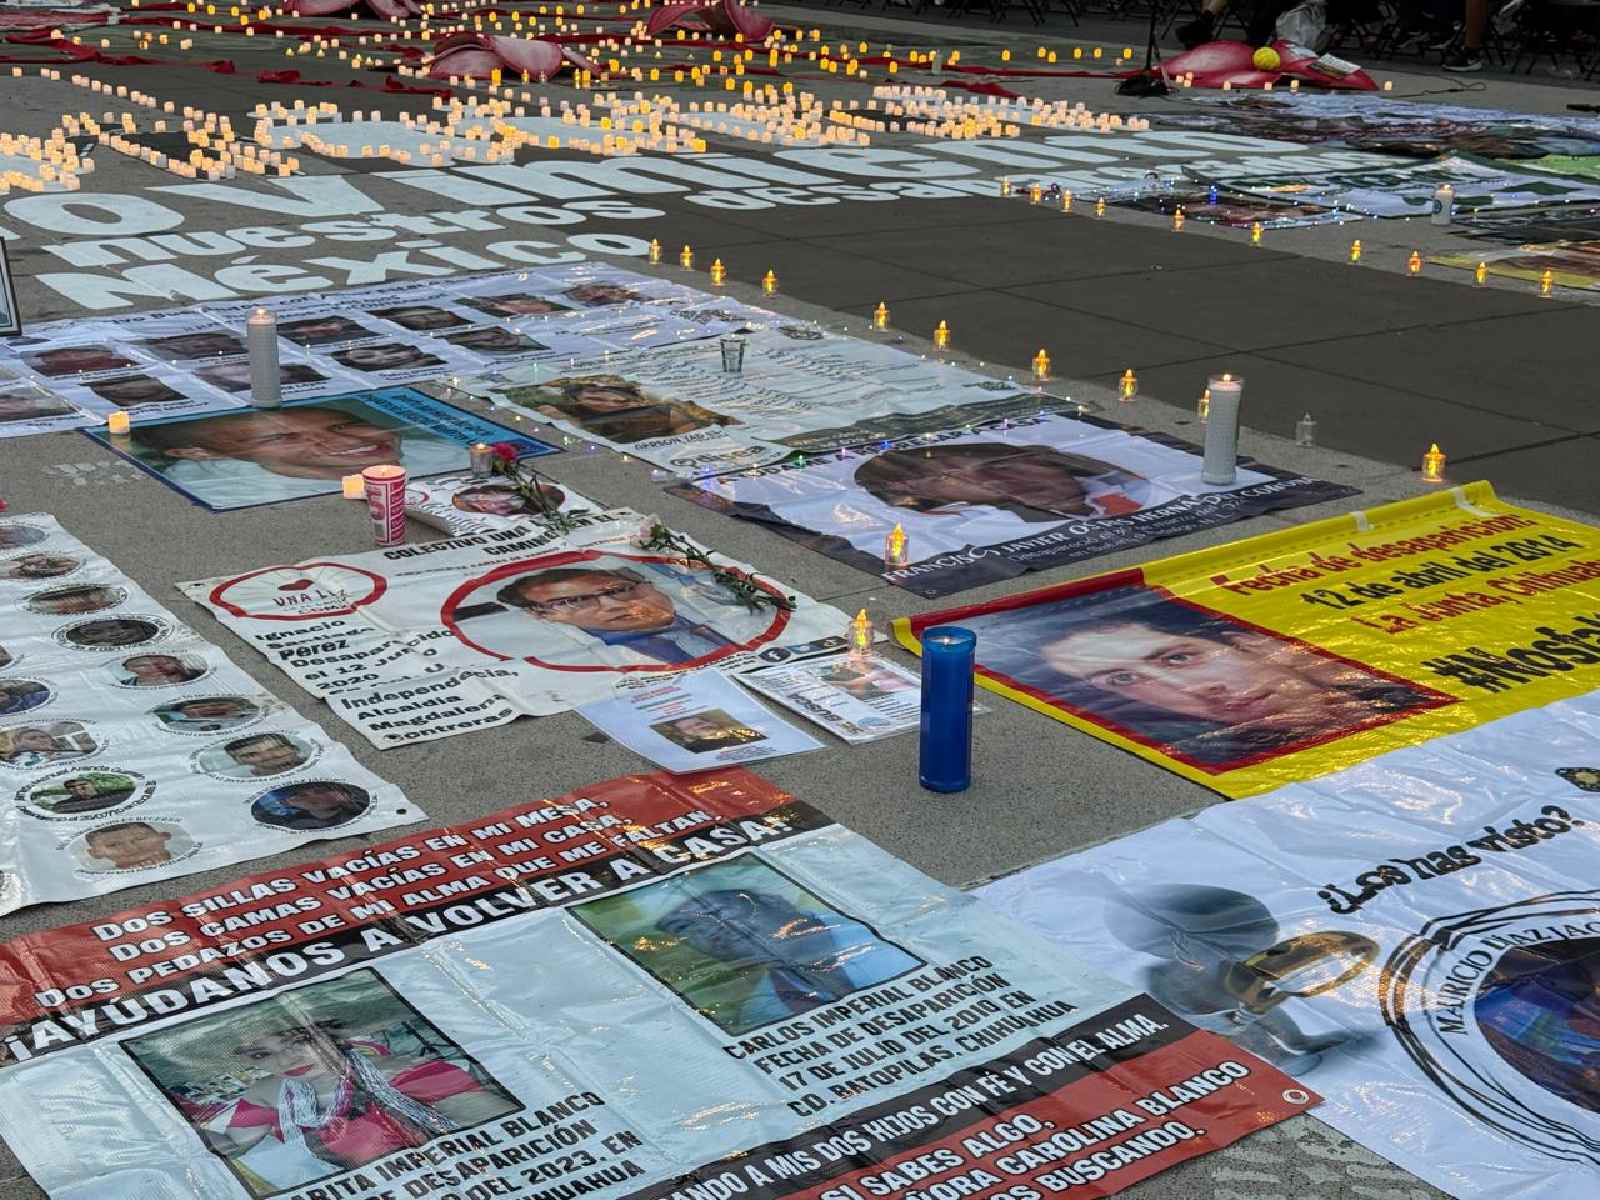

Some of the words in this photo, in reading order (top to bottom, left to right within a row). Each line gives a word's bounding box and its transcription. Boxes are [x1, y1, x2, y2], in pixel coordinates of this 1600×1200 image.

[34, 233, 653, 310] México
[42, 200, 666, 267] nuestros
[1300, 589, 1366, 610] 12
[1345, 581, 1405, 600] de
[1391, 561, 1473, 589] abril
[1451, 550, 1519, 573] del
[1490, 534, 1585, 561] 2014
[1307, 551, 1363, 572] de
[316, 673, 380, 690] 2020
[35, 978, 121, 1008] DOS
[127, 929, 293, 985] PEDAZOS
[297, 914, 346, 936] DE
[348, 899, 396, 922] MI
[401, 873, 492, 907] ALMA
[495, 855, 556, 882] QUE
[558, 841, 608, 863] ME
[610, 809, 723, 848] FALTAN.
[92, 911, 174, 942] DOS
[181, 877, 297, 918] SILLAS
[301, 844, 422, 884] VACÍAS
[424, 834, 468, 852] EN
[471, 822, 512, 842] MI
[109, 930, 191, 961] DOS
[200, 896, 322, 938] CAMAS
[327, 862, 446, 900] VACÍAS
[448, 850, 493, 871] EN
[498, 838, 538, 857] MI
[4, 941, 346, 1062] ¡AYÚDANOS
[359, 927, 402, 953] A
[404, 870, 602, 934] VOLVER
[608, 857, 652, 882] A
[721, 1019, 816, 1060] CARLOS
[810, 984, 916, 1028] IMPERIAL
[906, 955, 994, 993] BLANCO
[1436, 949, 1494, 1036] MAURICIO
[753, 1041, 833, 1076] FECHA
[827, 1026, 866, 1049] DE
[864, 971, 1012, 1038] DESAPARICIÓN
[778, 1069, 809, 1093] 17
[809, 1058, 848, 1081] DE
[848, 1039, 907, 1072] JULIO
[906, 1022, 951, 1047] DEL
[944, 998, 1003, 1032] 2010
[999, 988, 1038, 1012] EN
[785, 1093, 834, 1118] CD.
[954, 1000, 1080, 1057] CHIHUAHUA
[290, 1174, 377, 1200] RITA
[375, 1130, 504, 1182] IMPERIAL
[500, 1091, 605, 1138] BLANCO
[402, 1118, 598, 1199] DESAPARICIÓN
[656, 1170, 749, 1200] ANDO
[743, 1164, 776, 1187] A
[764, 1149, 823, 1180] MIS
[812, 1129, 872, 1163] DOS
[863, 1104, 940, 1143] HIJOS
[932, 1082, 984, 1118] CON
[982, 1070, 1017, 1098] FÉ
[1010, 1064, 1033, 1087] Y
[1025, 1044, 1077, 1078] CON
[1069, 1039, 1106, 1064] EL
[1096, 1013, 1171, 1054] ALMA.
[996, 1108, 1146, 1175] CAROLINA
[1135, 1060, 1252, 1117] BLANCO
[1037, 1120, 1206, 1192] BUSCANDO.
[464, 1176, 523, 1200] DEL
[601, 1130, 644, 1156] EN
[820, 1182, 866, 1200] SI
[860, 1149, 964, 1197] SABES
